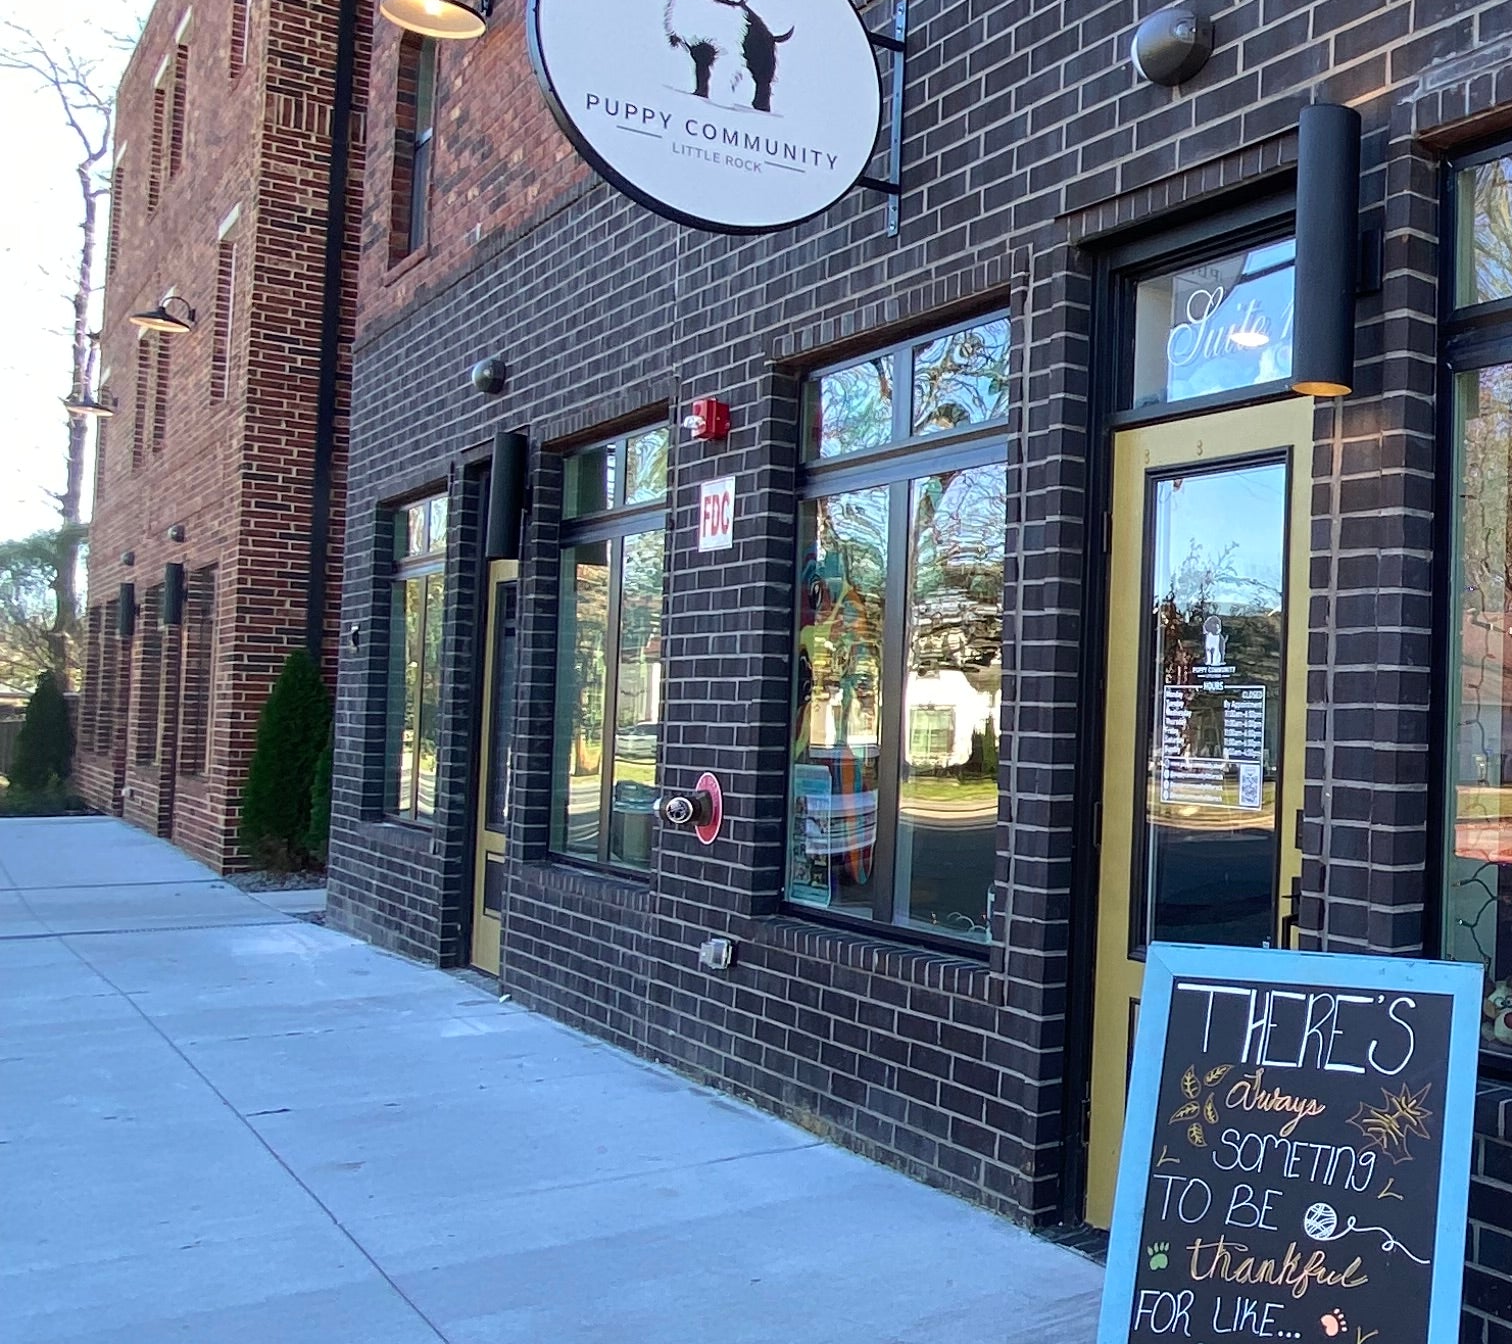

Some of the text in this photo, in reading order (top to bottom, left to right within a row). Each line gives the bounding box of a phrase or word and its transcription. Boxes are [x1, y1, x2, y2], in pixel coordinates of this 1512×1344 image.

[585, 92, 839, 170] PUPPY COMMUNITY
[672, 142, 762, 174] LITTLE ROCK
[702, 490, 731, 538] FDC
[1177, 982, 1416, 1076] THERE'S
[1153, 1173, 1284, 1232] TO BE
[1185, 1234, 1369, 1299] thankful
[1133, 1289, 1194, 1338] FOR
